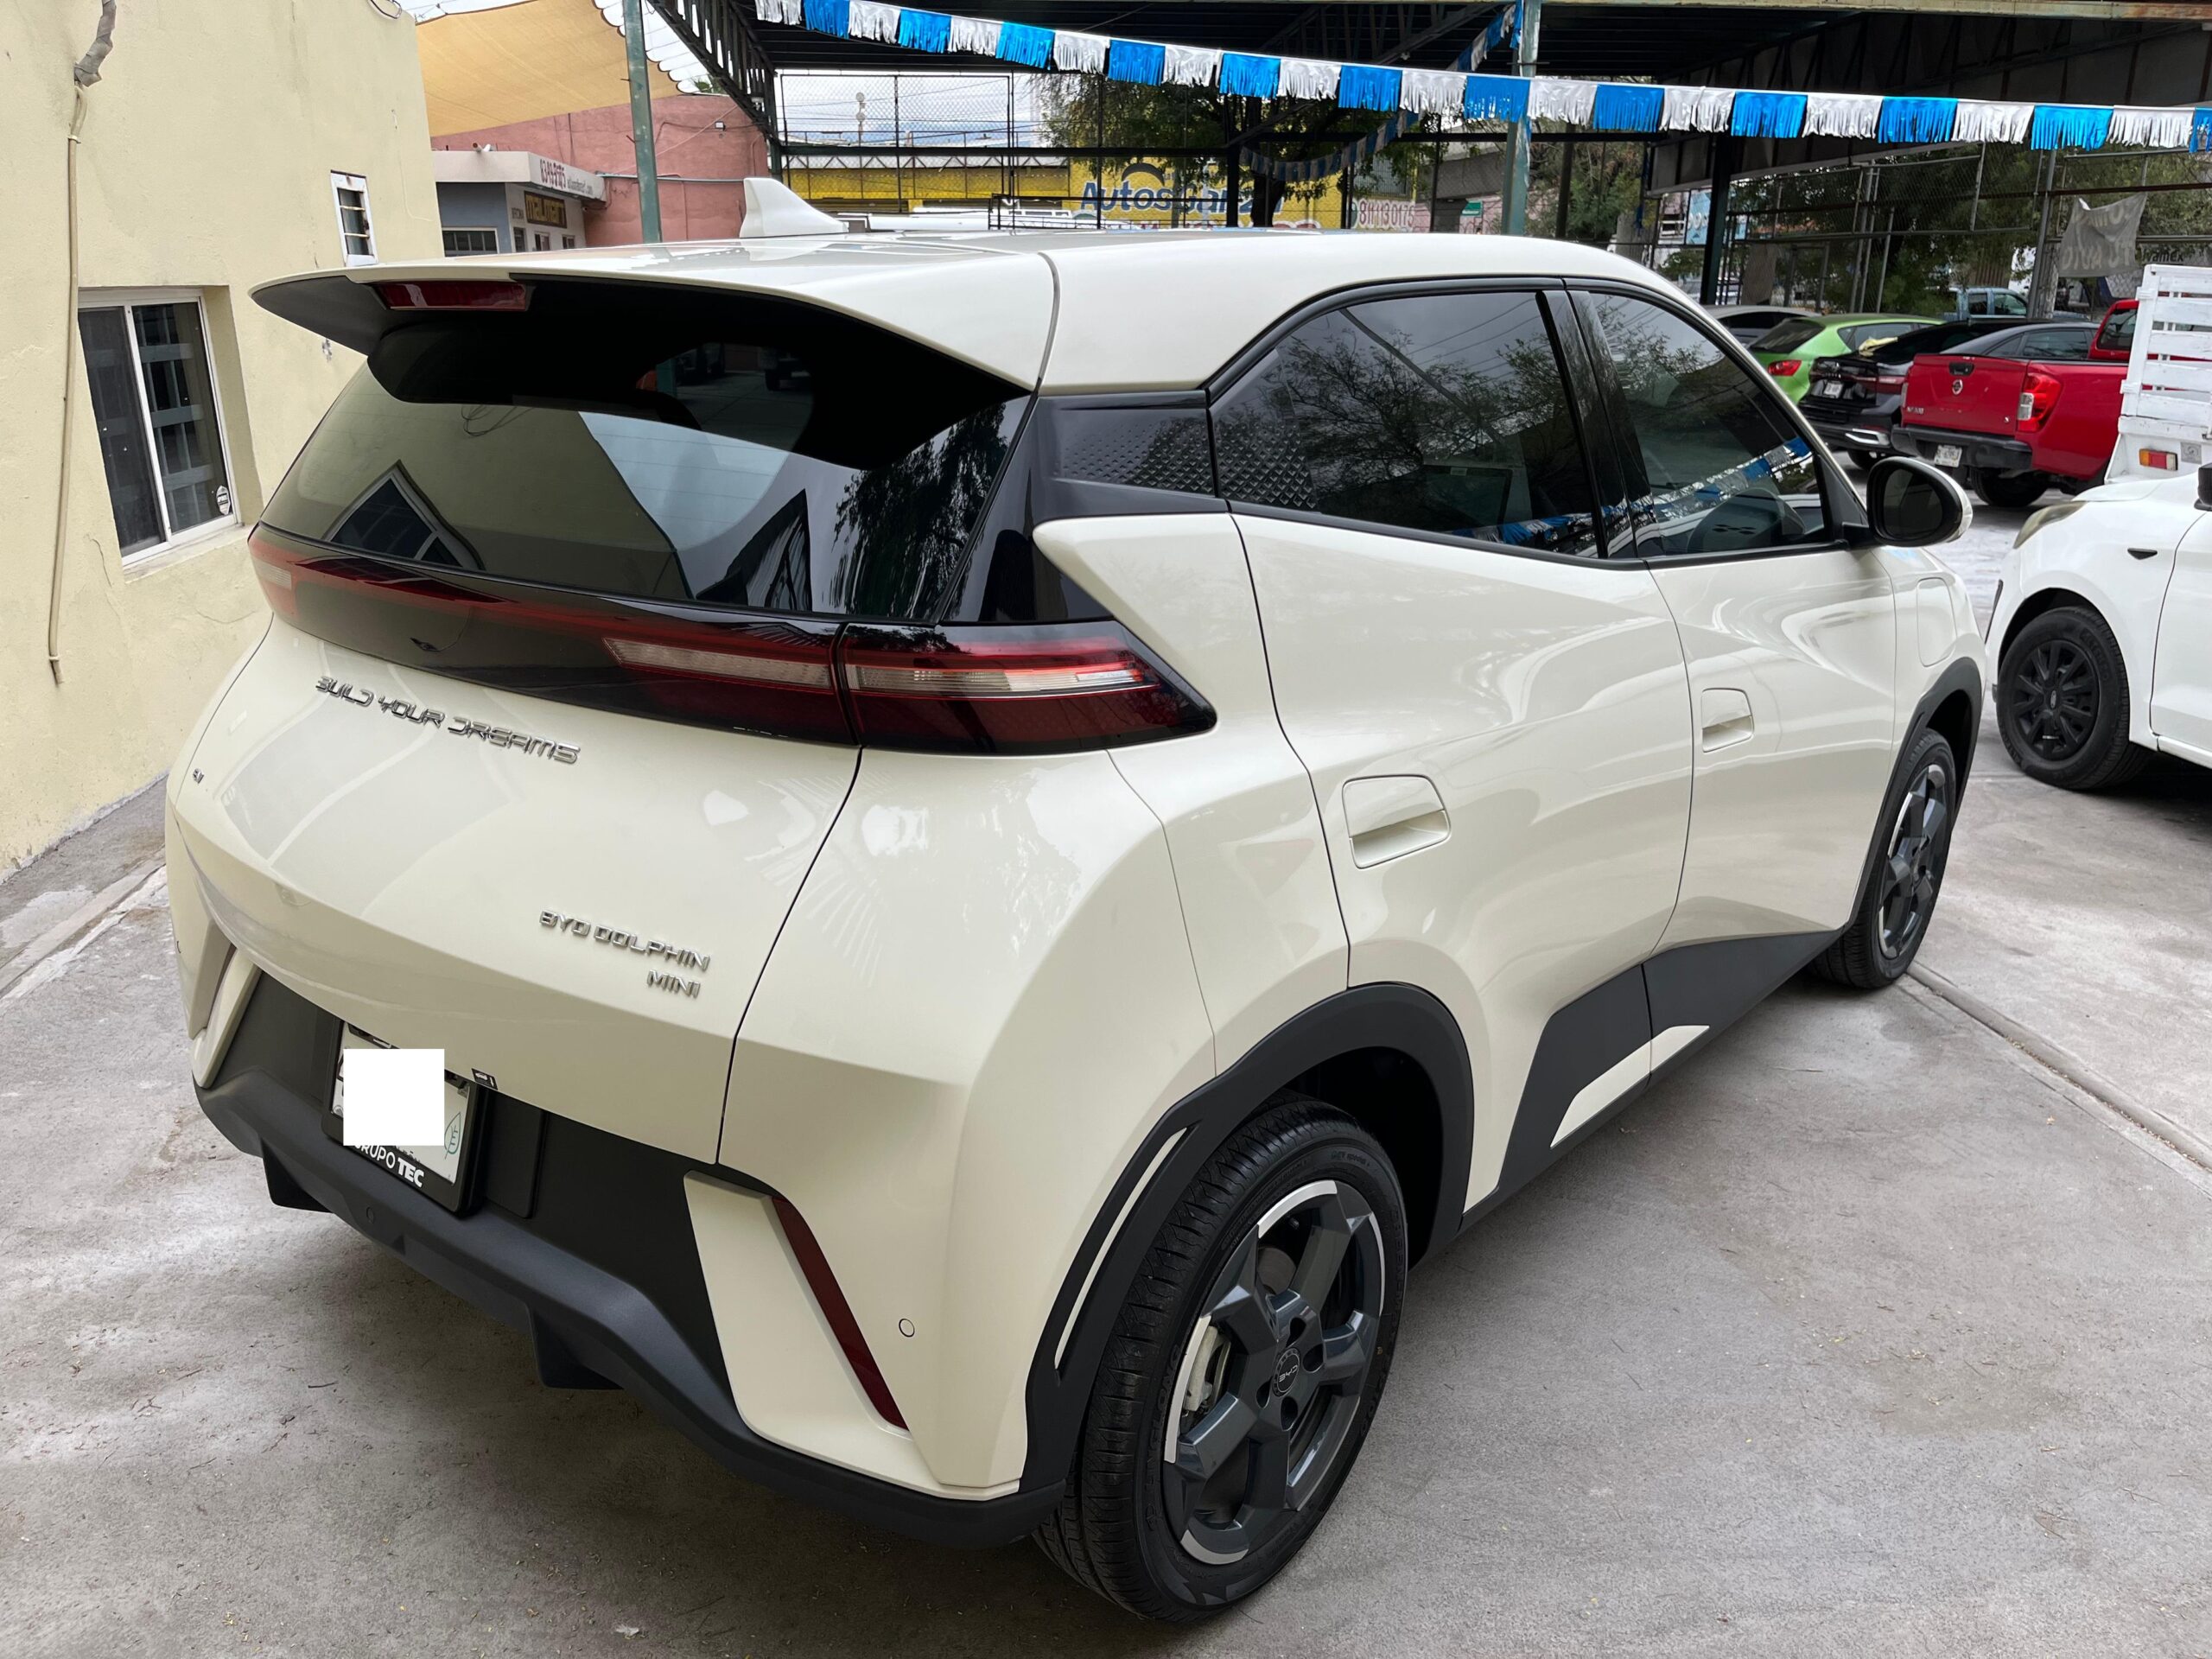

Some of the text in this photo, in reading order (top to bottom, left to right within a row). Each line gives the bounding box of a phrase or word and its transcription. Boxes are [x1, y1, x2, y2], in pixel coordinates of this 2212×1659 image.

[315, 676, 581, 764] BUILD YOUR DREAMS
[539, 911, 711, 972] BYD DOLPHIN
[647, 969, 701, 999] MINI
[354, 1145, 396, 1169] RUPO
[397, 1157, 424, 1188] TEC
